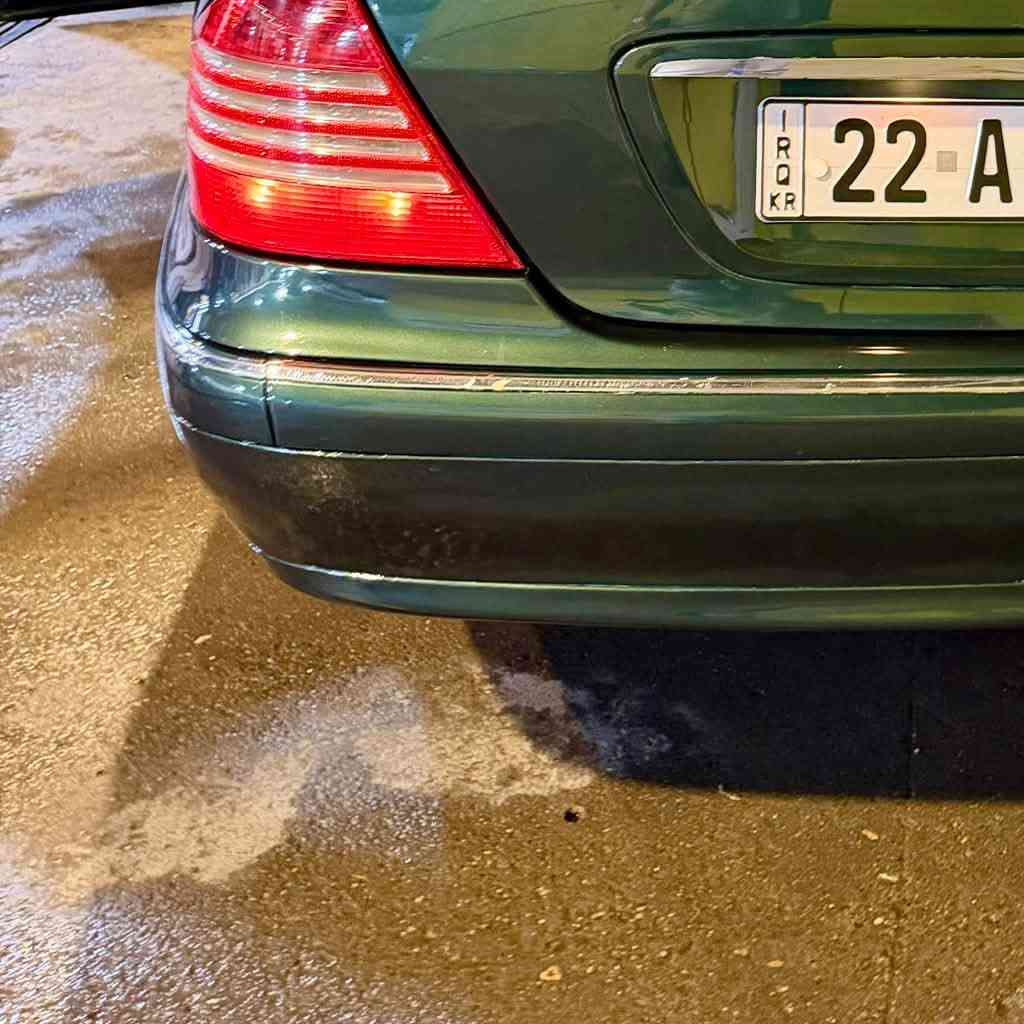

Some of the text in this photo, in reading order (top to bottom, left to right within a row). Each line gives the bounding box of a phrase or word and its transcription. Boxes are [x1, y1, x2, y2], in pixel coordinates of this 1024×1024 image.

[832, 118, 927, 203] 22
[968, 119, 1013, 203] A
[769, 192, 796, 211] KR
